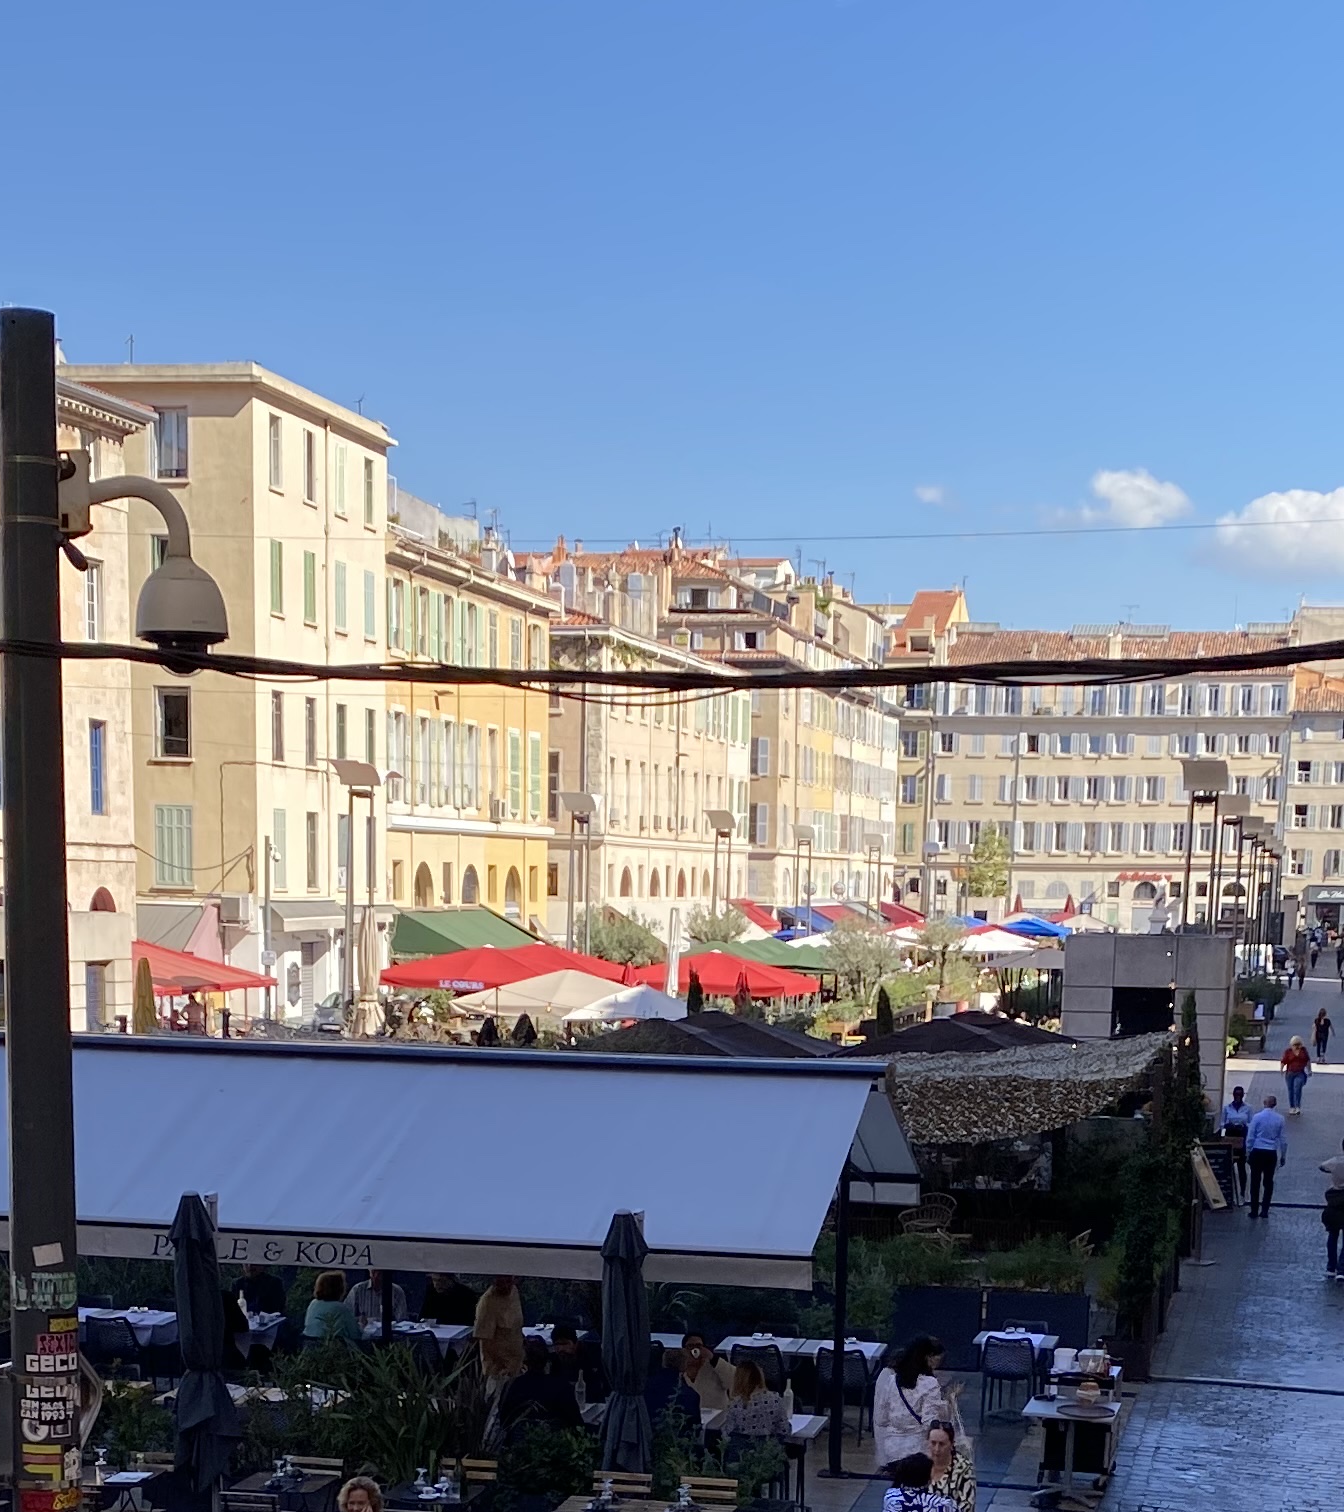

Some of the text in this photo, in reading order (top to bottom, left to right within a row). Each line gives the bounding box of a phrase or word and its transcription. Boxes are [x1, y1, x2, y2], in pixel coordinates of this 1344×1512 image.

[263, 1242, 284, 1261] &
[294, 1241, 374, 1266] KOPA
[41, 1409, 65, 1420] 1993
